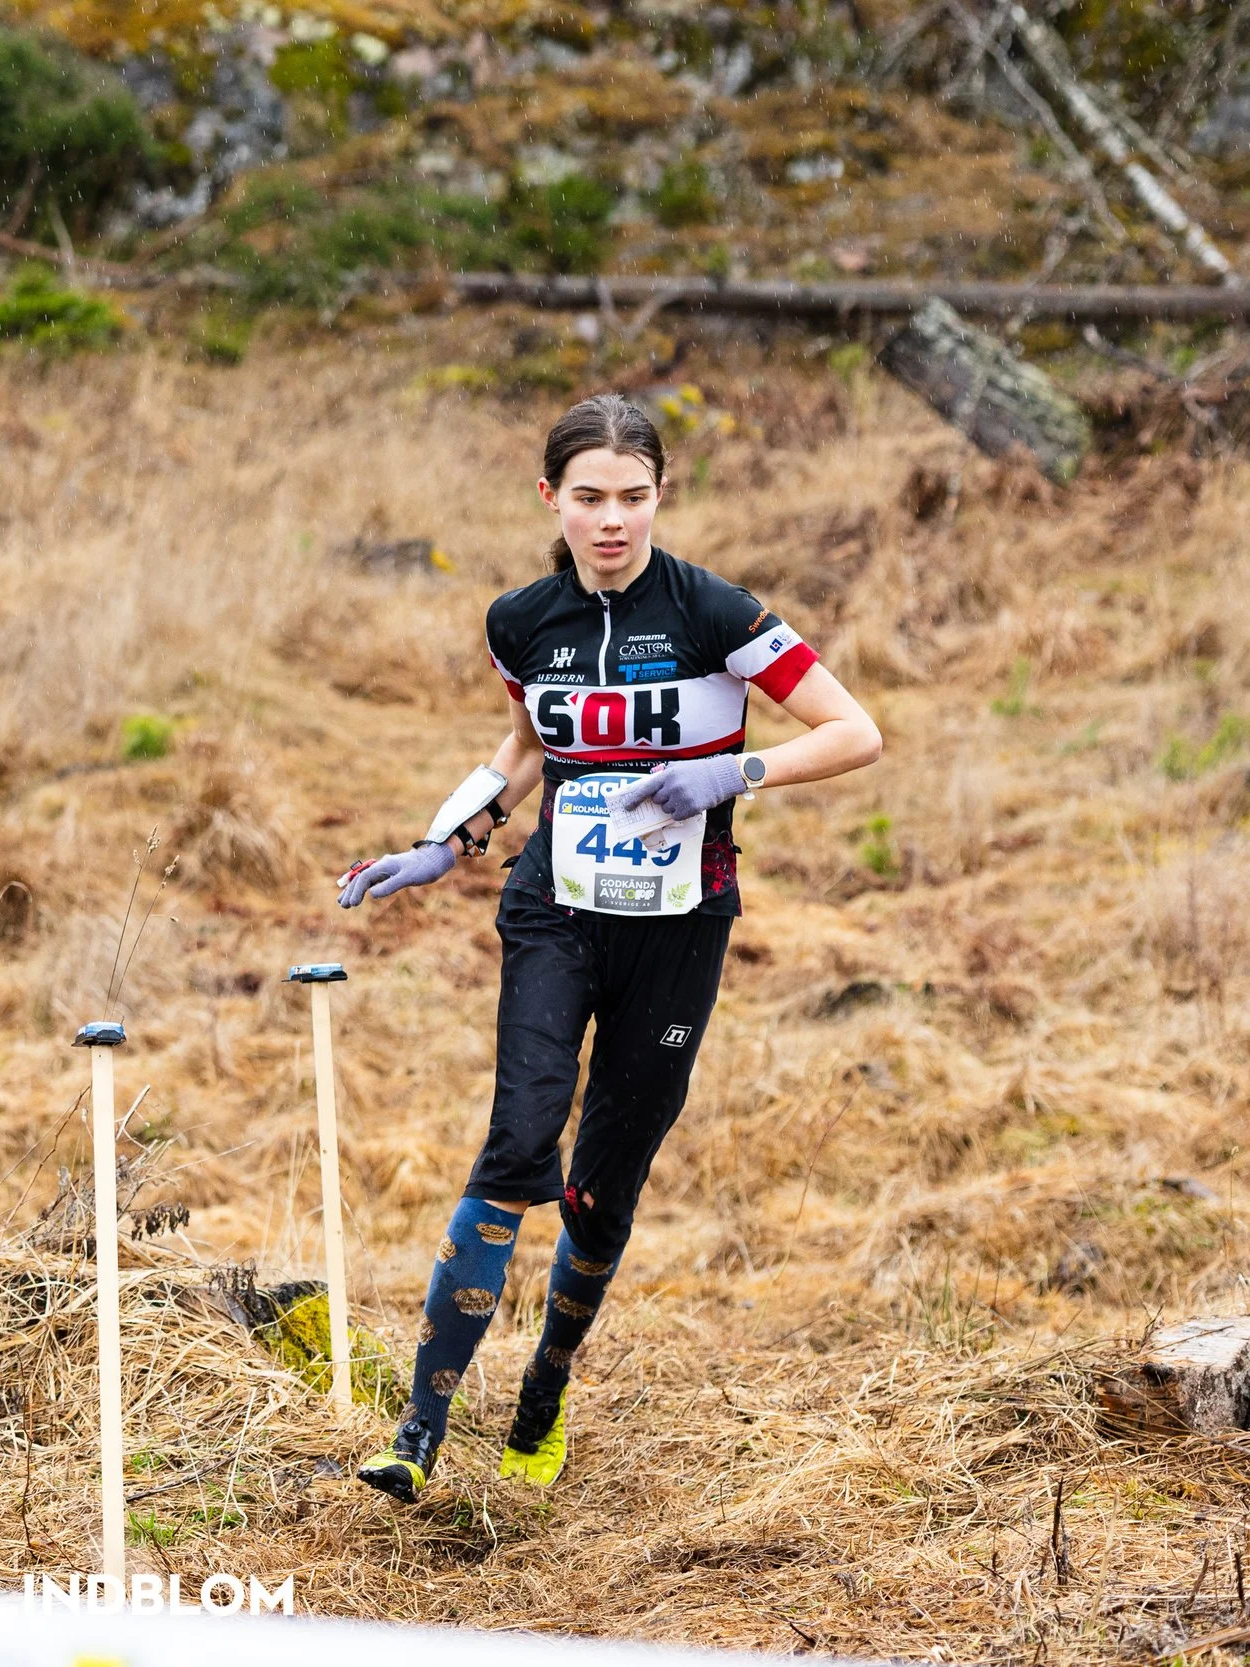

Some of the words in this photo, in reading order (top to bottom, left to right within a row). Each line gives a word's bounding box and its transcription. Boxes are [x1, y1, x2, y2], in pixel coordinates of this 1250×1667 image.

[627, 633, 667, 642] noname
[619, 642, 675, 656] CASTOR
[537, 673, 585, 683] HEDERN
[638, 668, 676, 678] SERVICE
[537, 687, 681, 748] SOK
[573, 804, 612, 815] KOLMÅRD
